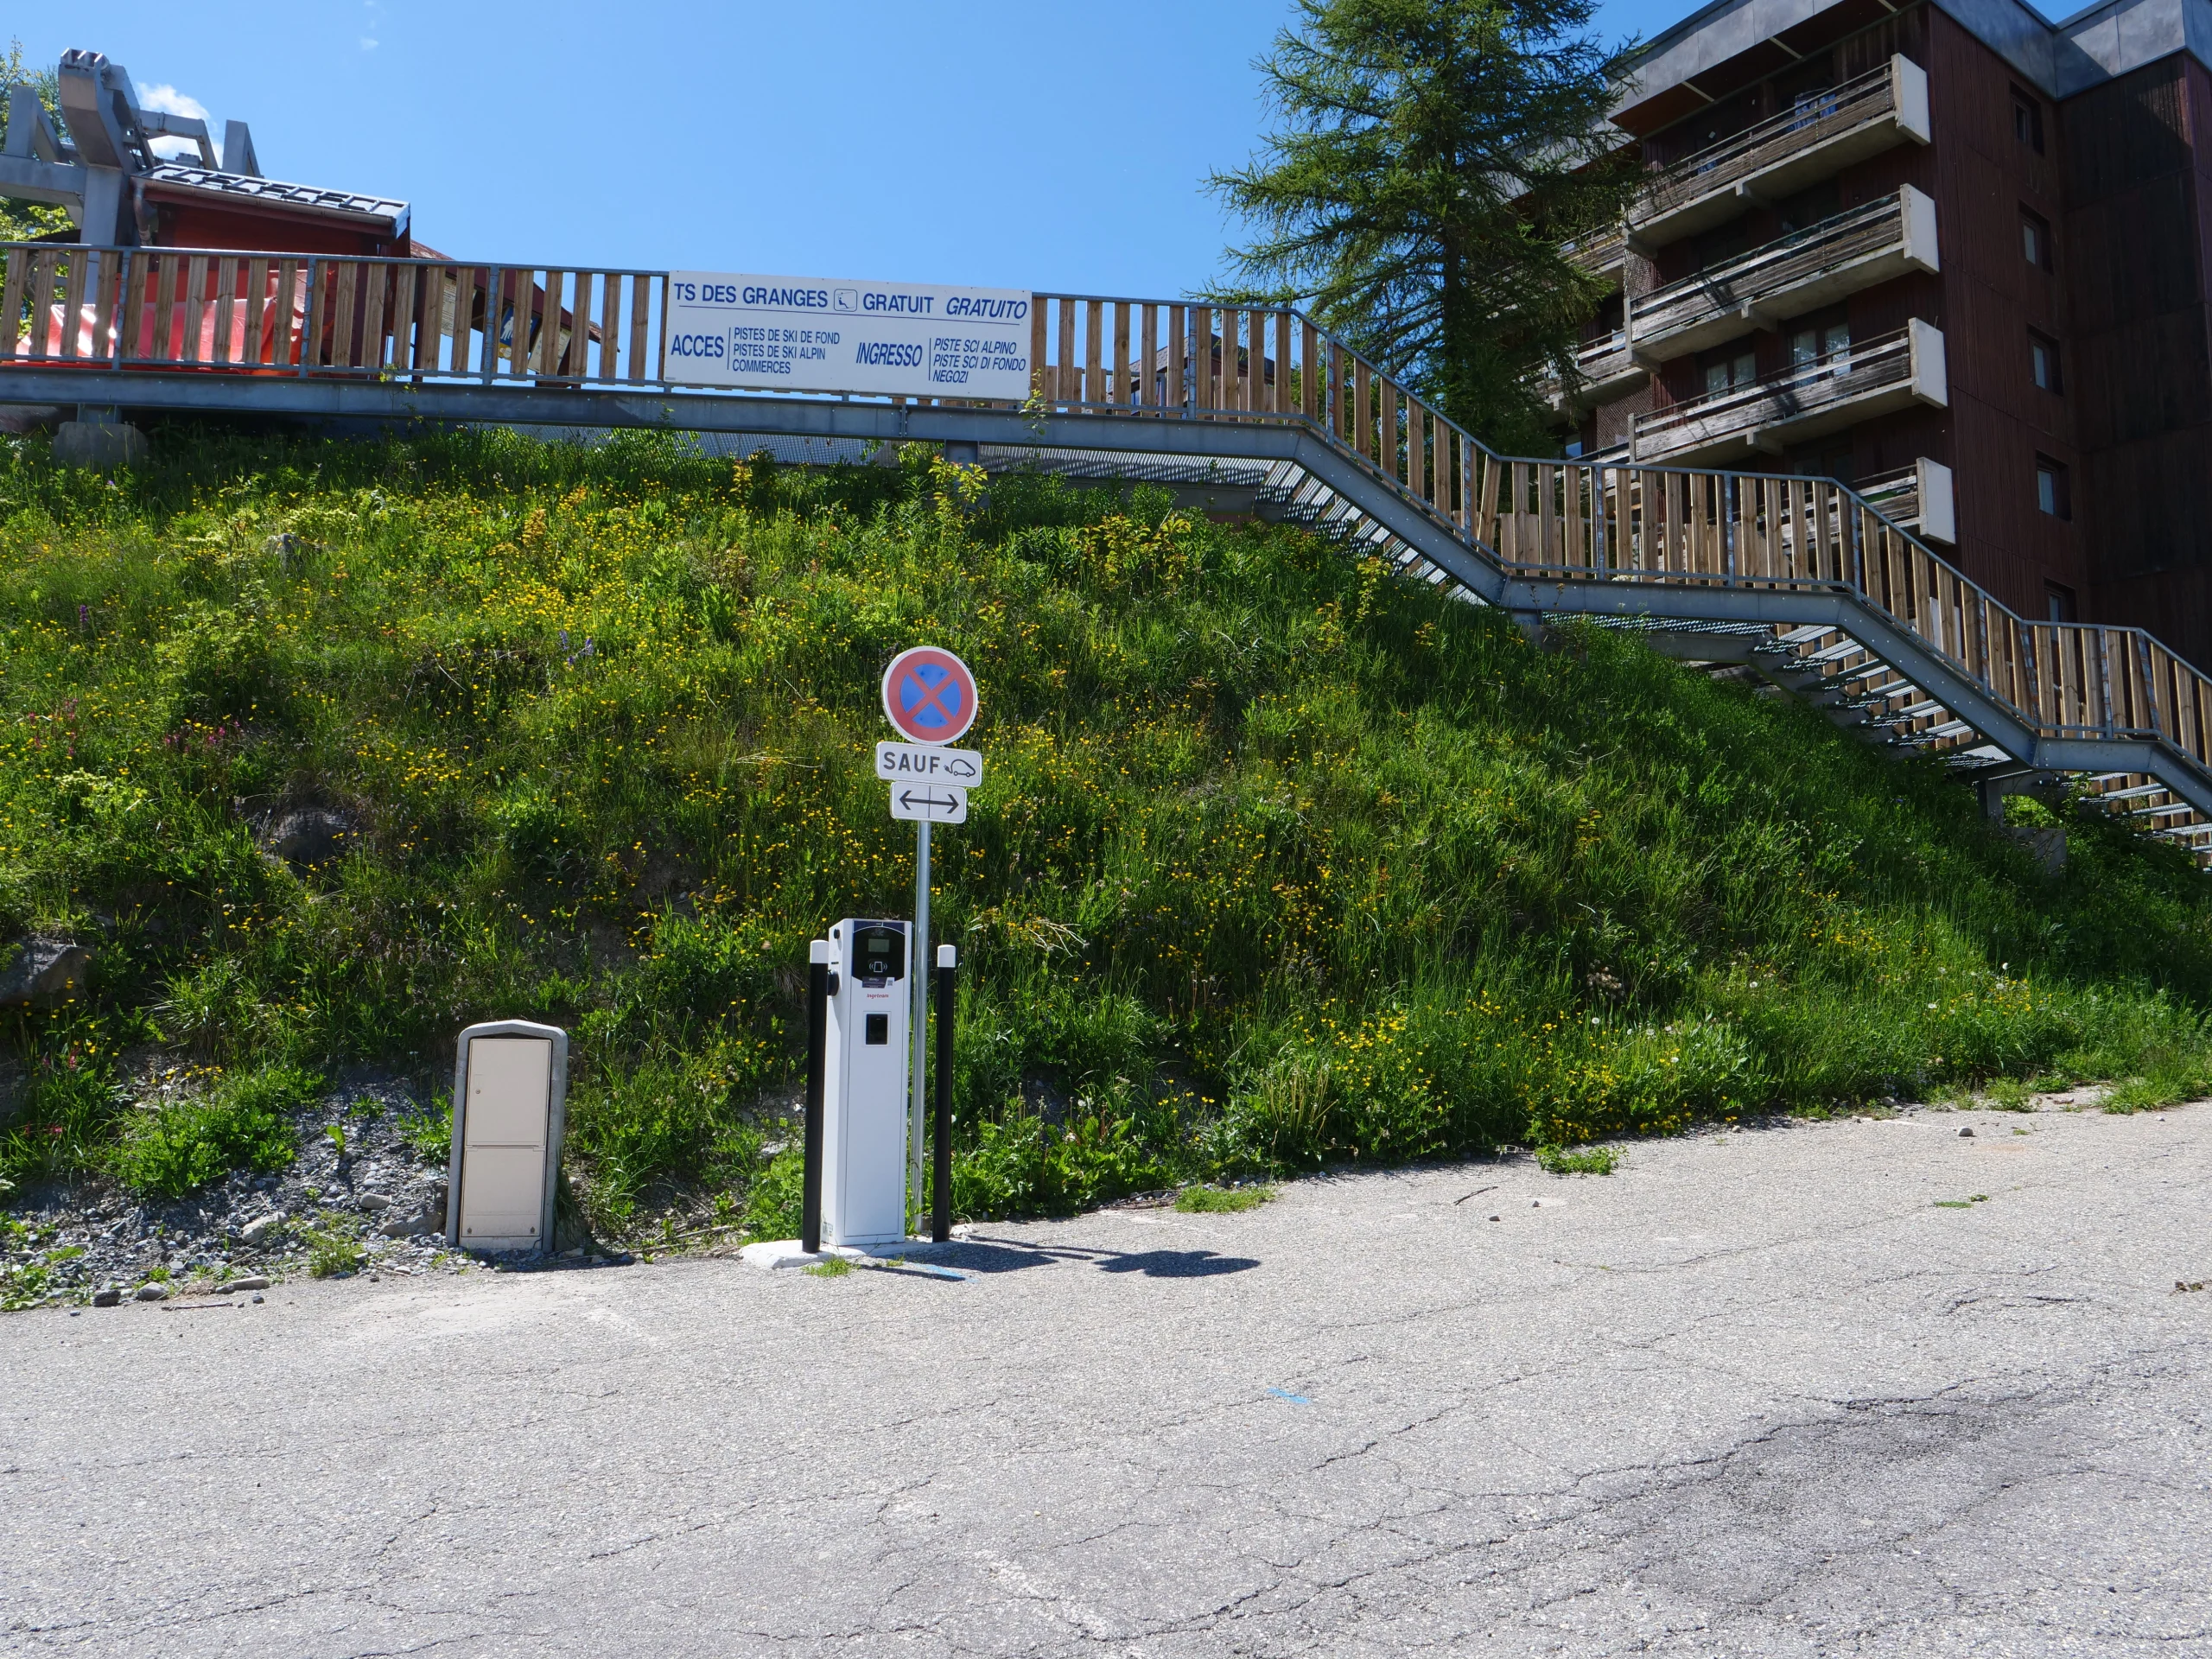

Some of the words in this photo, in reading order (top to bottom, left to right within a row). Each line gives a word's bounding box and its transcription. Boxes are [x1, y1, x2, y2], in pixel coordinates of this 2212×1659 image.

[674, 283, 696, 301] TS
[702, 284, 736, 302] DES
[742, 287, 828, 308] GRANGES
[863, 293, 934, 314] GRATUIT
[946, 297, 1027, 319] GRATUITO
[734, 327, 765, 341] PISTES
[767, 328, 779, 341] DE
[783, 329, 798, 342] SKI
[800, 330, 812, 344] DE
[815, 332, 840, 345] FOND
[671, 334, 724, 358] ACCES
[734, 343, 764, 358] PISTES
[766, 345, 779, 358] DE
[782, 346, 797, 359] SKI
[799, 347, 826, 360] ALPIN
[855, 341, 923, 367] INGRESSO
[933, 337, 962, 352] PISTE
[963, 339, 980, 353] SCI
[981, 340, 1017, 355] ALPINO
[733, 359, 791, 374] COMMERCES
[932, 353, 961, 368] PISTE
[962, 355, 978, 369] SCI
[980, 357, 990, 370] DI
[993, 358, 1027, 372] FONDO
[932, 369, 969, 384] NEGOZI
[883, 751, 940, 773] SAUF
